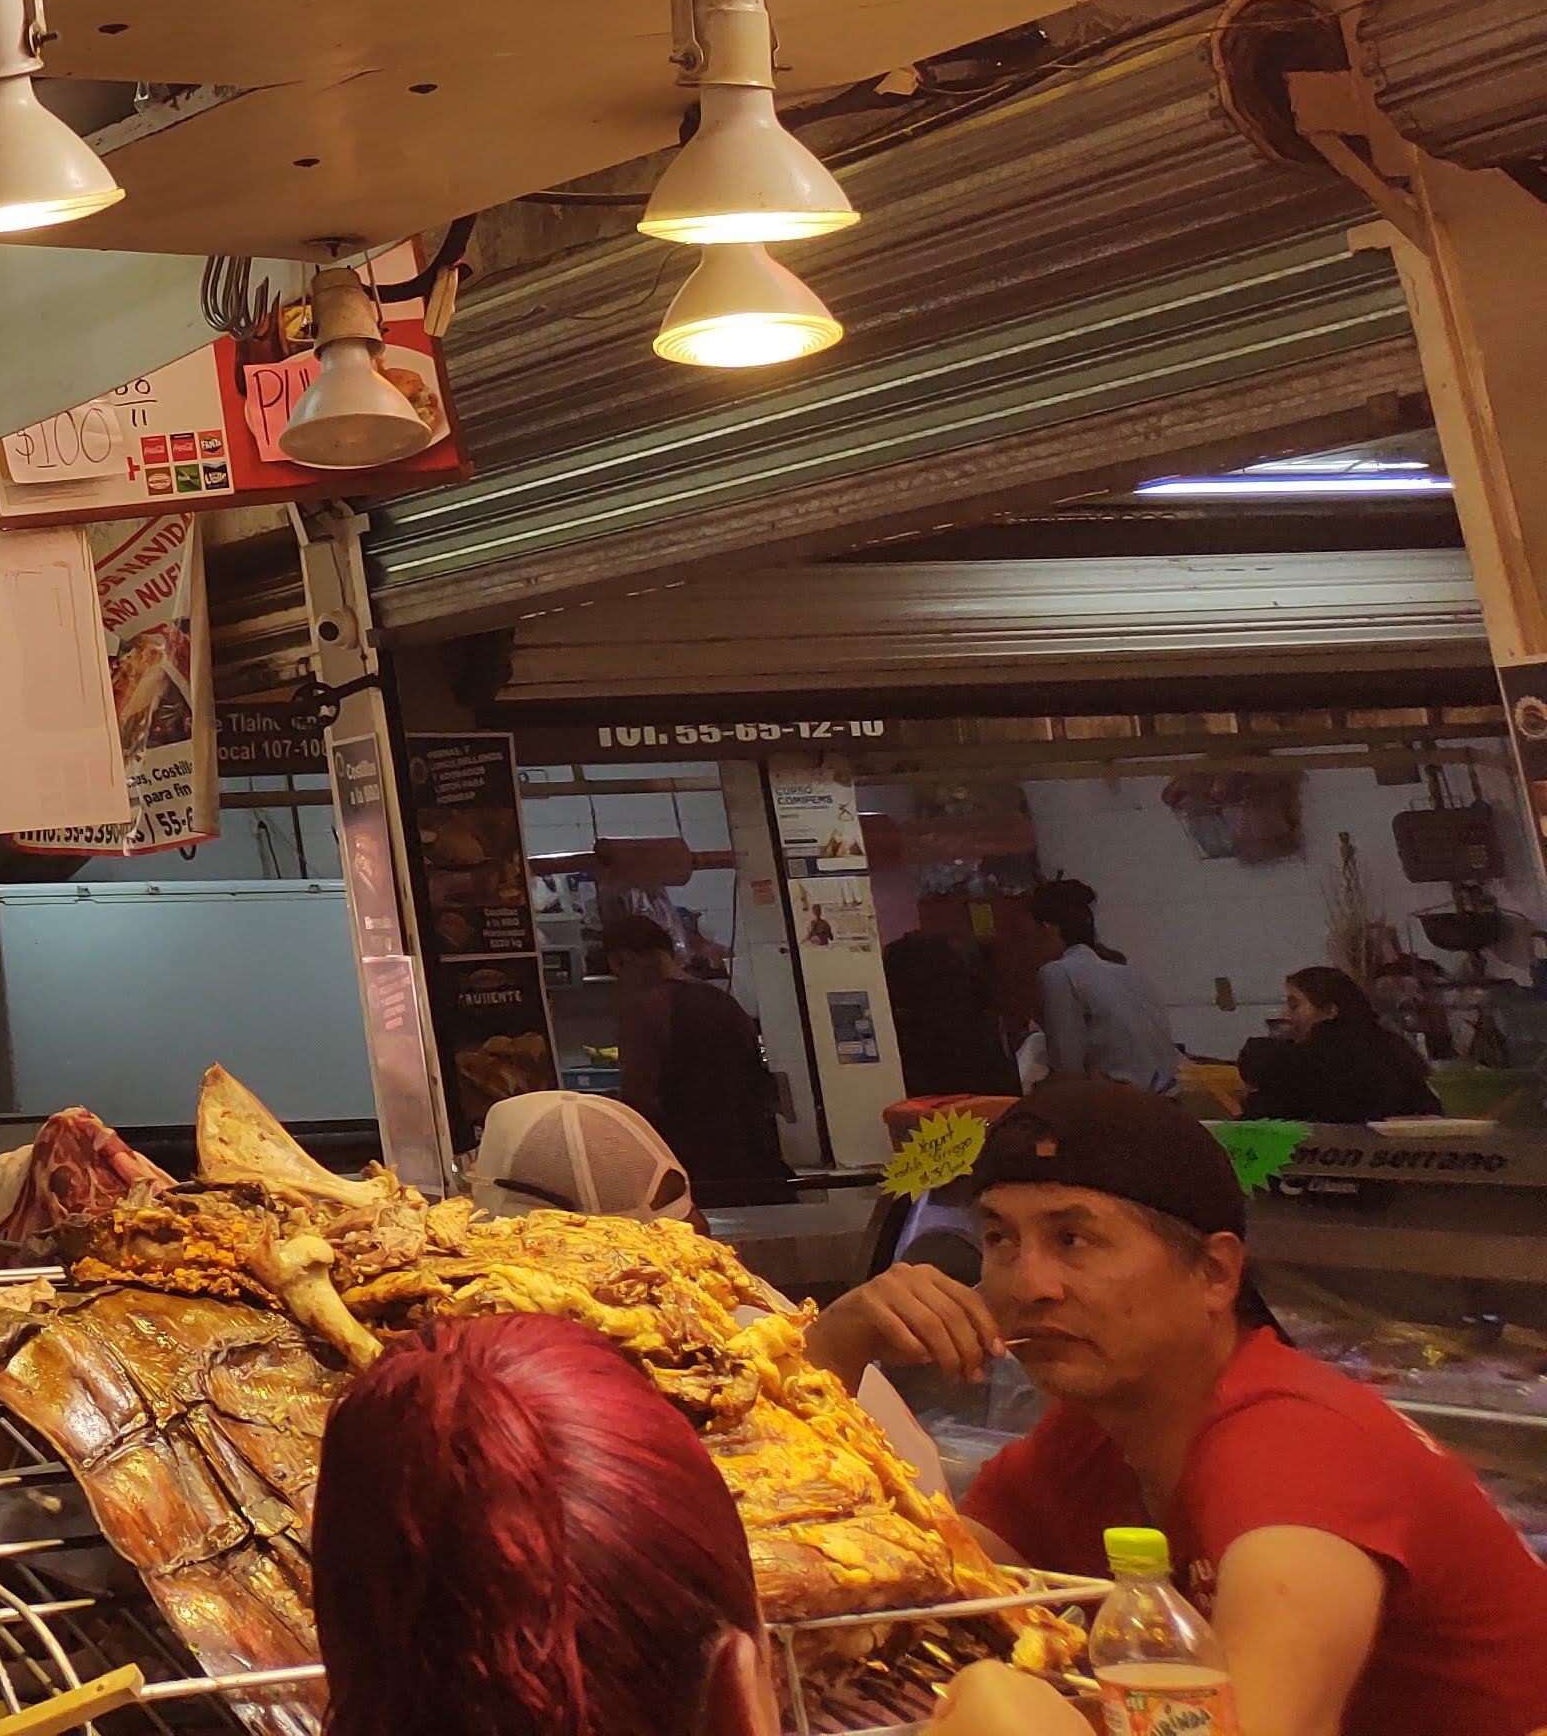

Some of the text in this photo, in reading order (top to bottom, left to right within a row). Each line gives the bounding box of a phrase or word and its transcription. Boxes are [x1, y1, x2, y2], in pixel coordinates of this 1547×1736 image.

[15, 407, 112, 468] $100
[102, 597, 140, 633] AÑO
[218, 740, 256, 760] ocal
[143, 789, 174, 806] para
